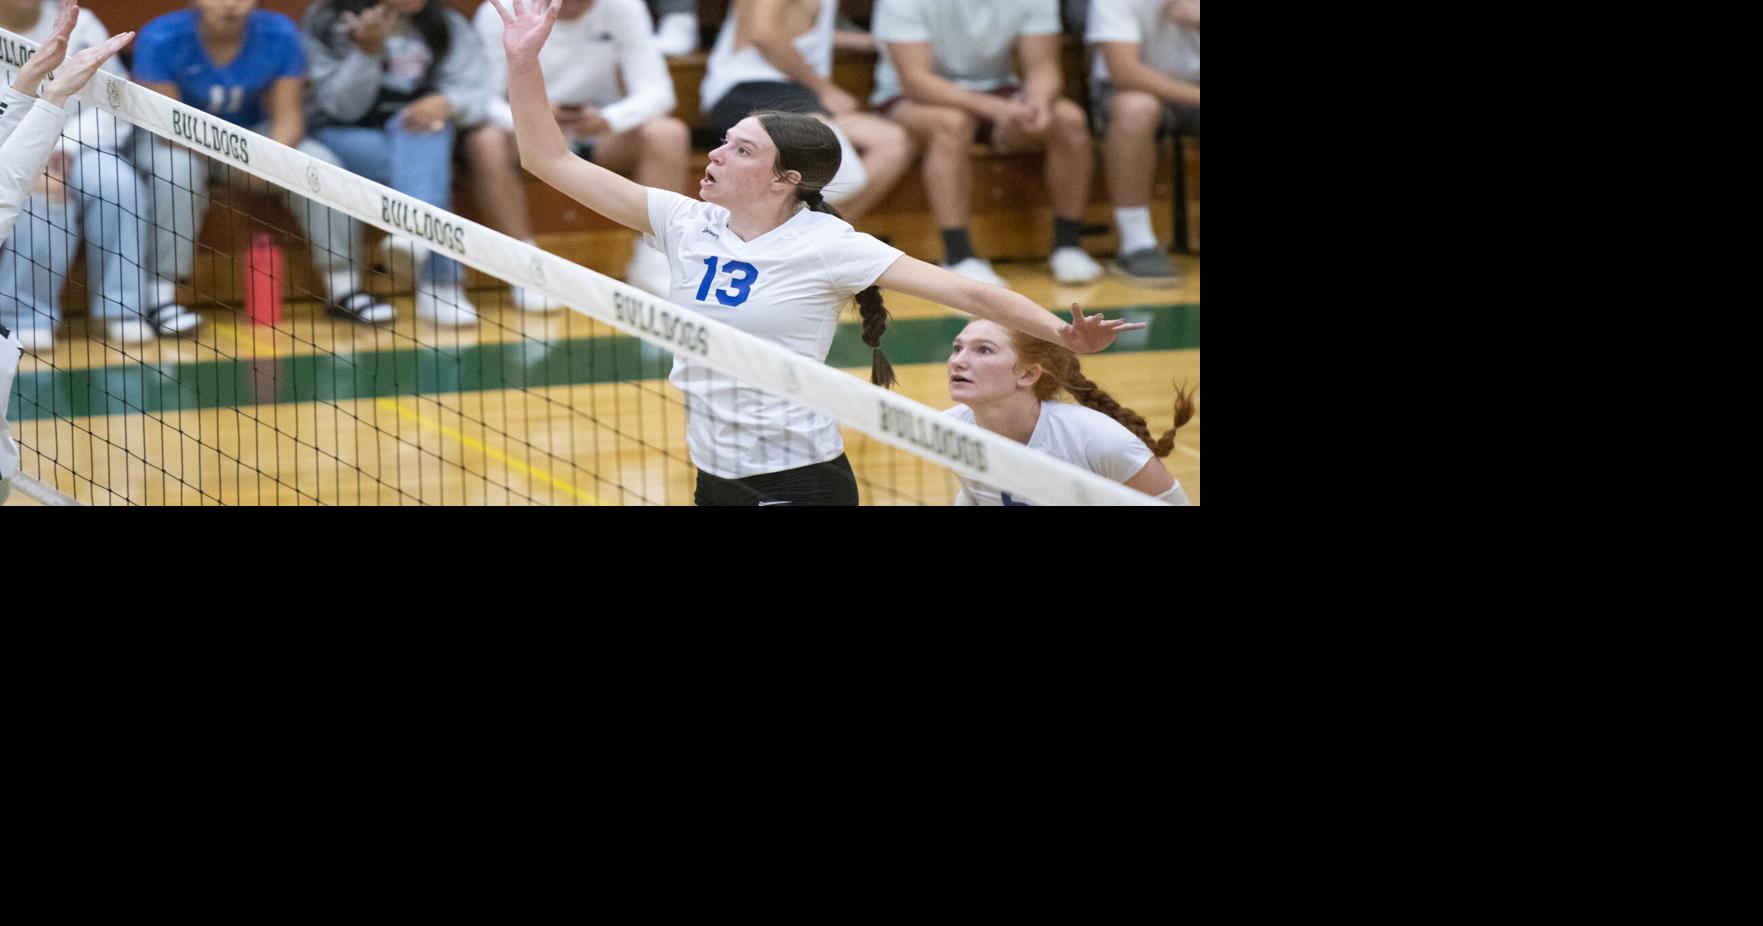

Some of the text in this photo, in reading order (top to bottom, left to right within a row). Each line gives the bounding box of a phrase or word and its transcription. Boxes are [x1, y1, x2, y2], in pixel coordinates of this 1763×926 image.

[172, 109, 249, 164] BULLDOGS
[382, 195, 465, 254] BULLDOGS
[696, 256, 758, 307] 13
[614, 291, 709, 356] BULLDOGS
